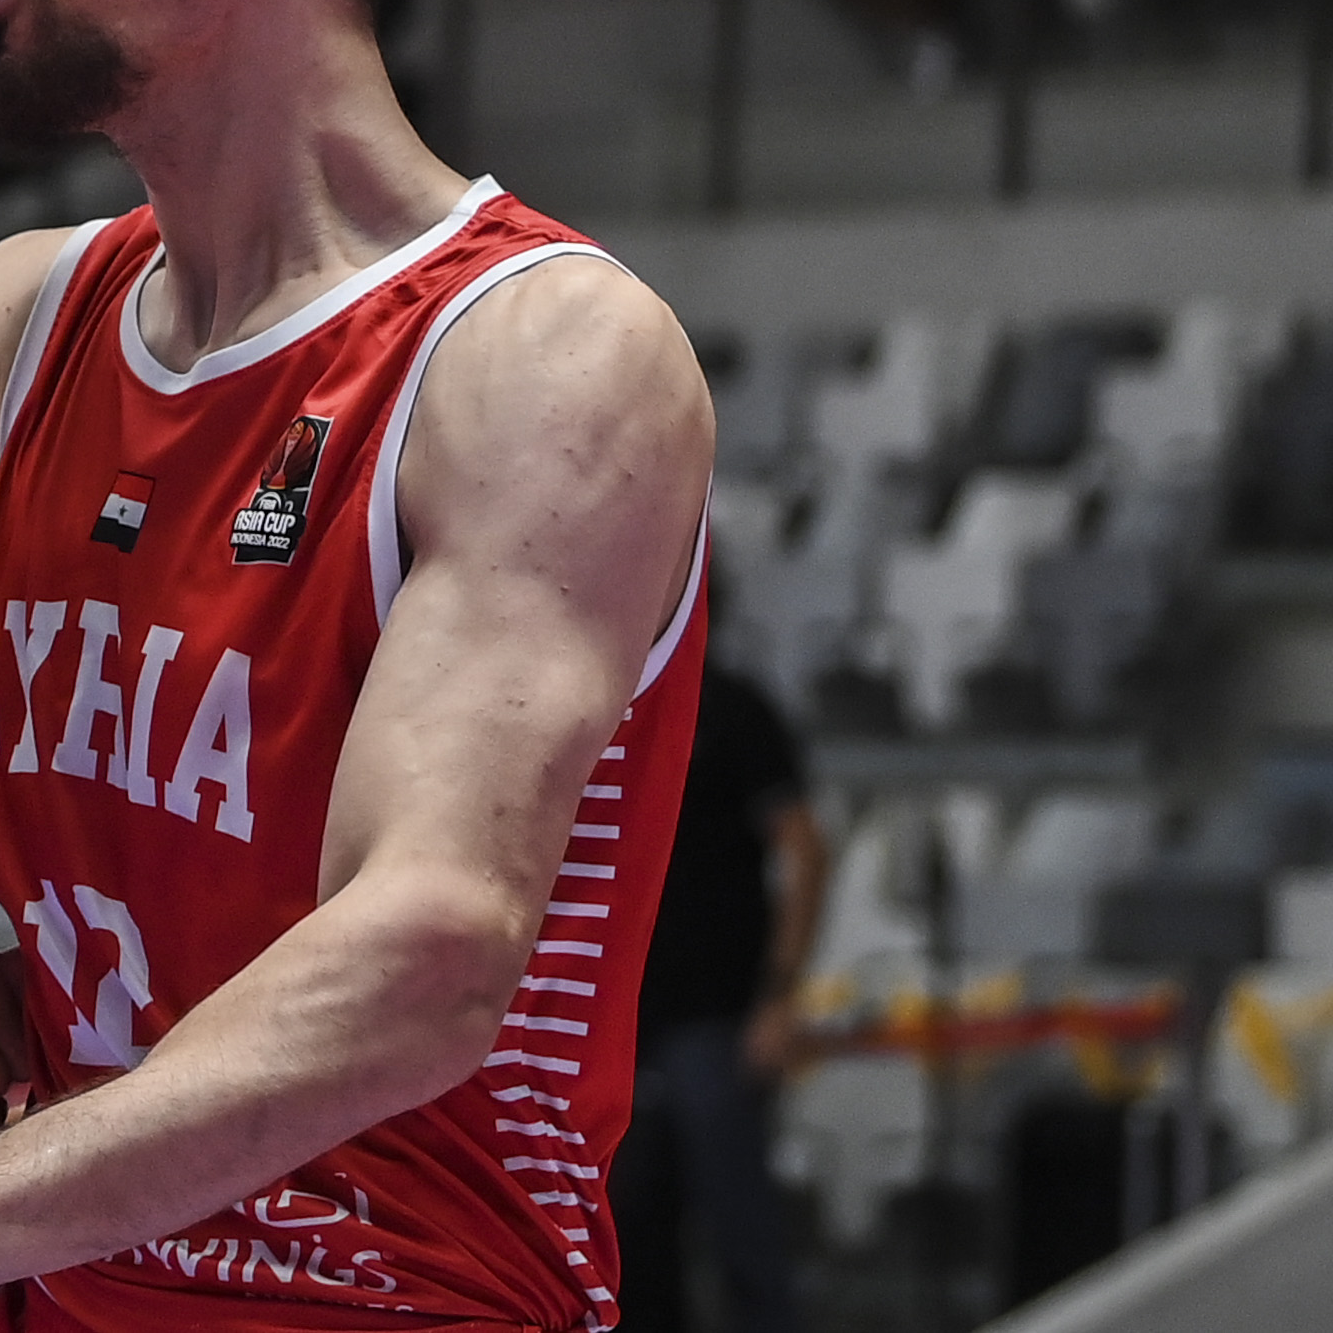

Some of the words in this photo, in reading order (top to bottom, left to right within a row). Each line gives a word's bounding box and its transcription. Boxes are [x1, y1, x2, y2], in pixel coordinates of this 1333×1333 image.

[233, 510, 265, 532] ASIA
[263, 512, 297, 535] CUP
[266, 534, 291, 550] 2022
[146, 1238, 398, 1294] WINGS
